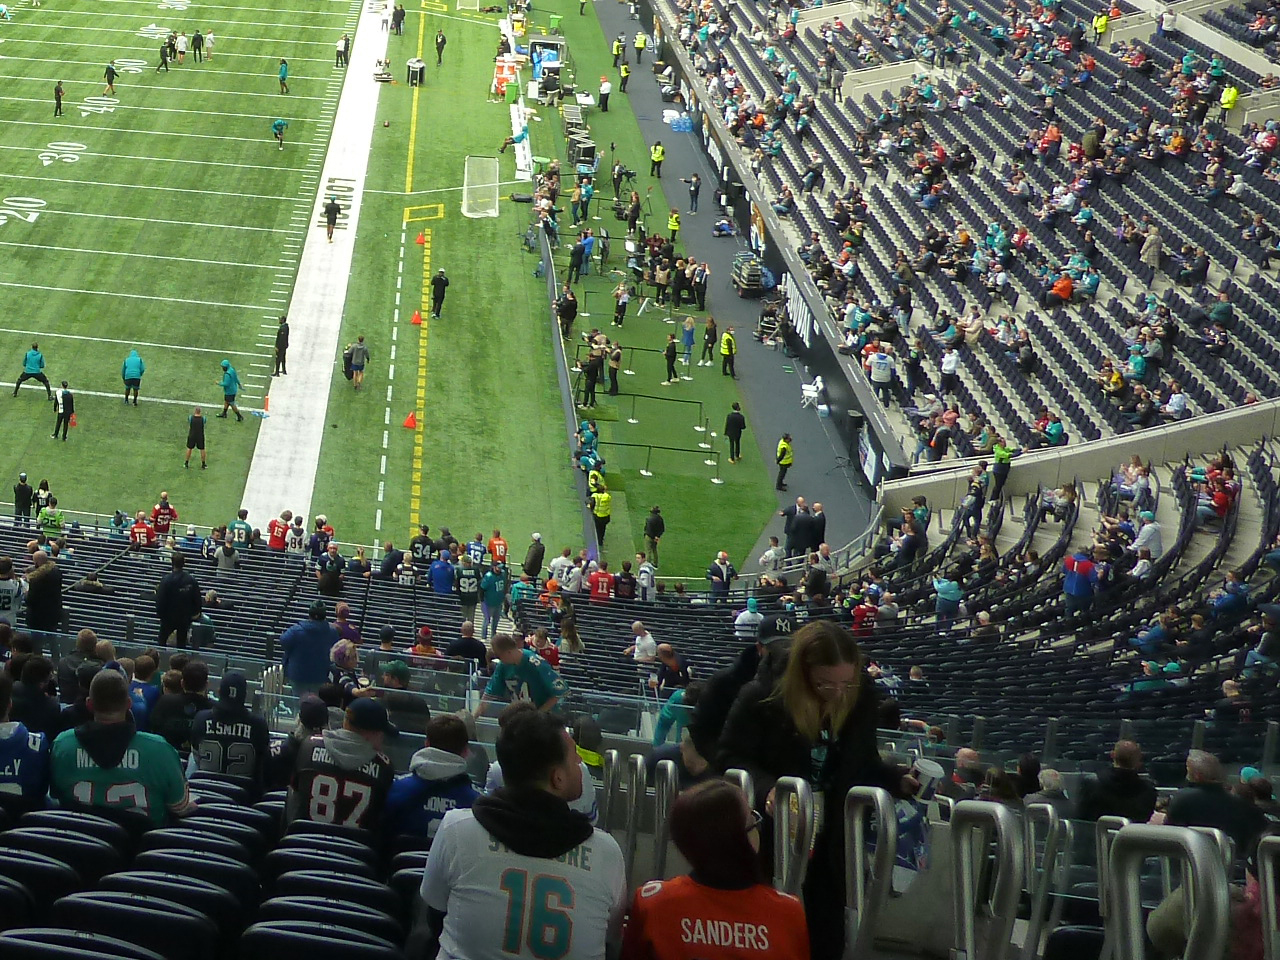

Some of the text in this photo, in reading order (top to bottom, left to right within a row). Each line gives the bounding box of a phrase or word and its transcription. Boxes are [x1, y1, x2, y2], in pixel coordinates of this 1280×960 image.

[77, 97, 120, 114] 40
[38, 142, 87, 162] 30
[43, 517, 57, 527] 25
[135, 533, 148, 544] 15
[233, 529, 246, 541] 13
[273, 527, 283, 537] 15
[290, 538, 304, 549] 84
[414, 543, 431, 559] 34
[495, 545, 505, 556] 18
[470, 550, 481, 564] 13
[459, 578, 478, 593] 92
[775, 618, 792, 633] NY
[205, 719, 251, 739] E.SMITH
[76, 747, 139, 769] MANO
[198, 740, 255, 777] 22
[309, 774, 372, 828] 87
[423, 796, 456, 813] JONES
[500, 867, 575, 959] 16
[680, 917, 770, 951] SANDERS
